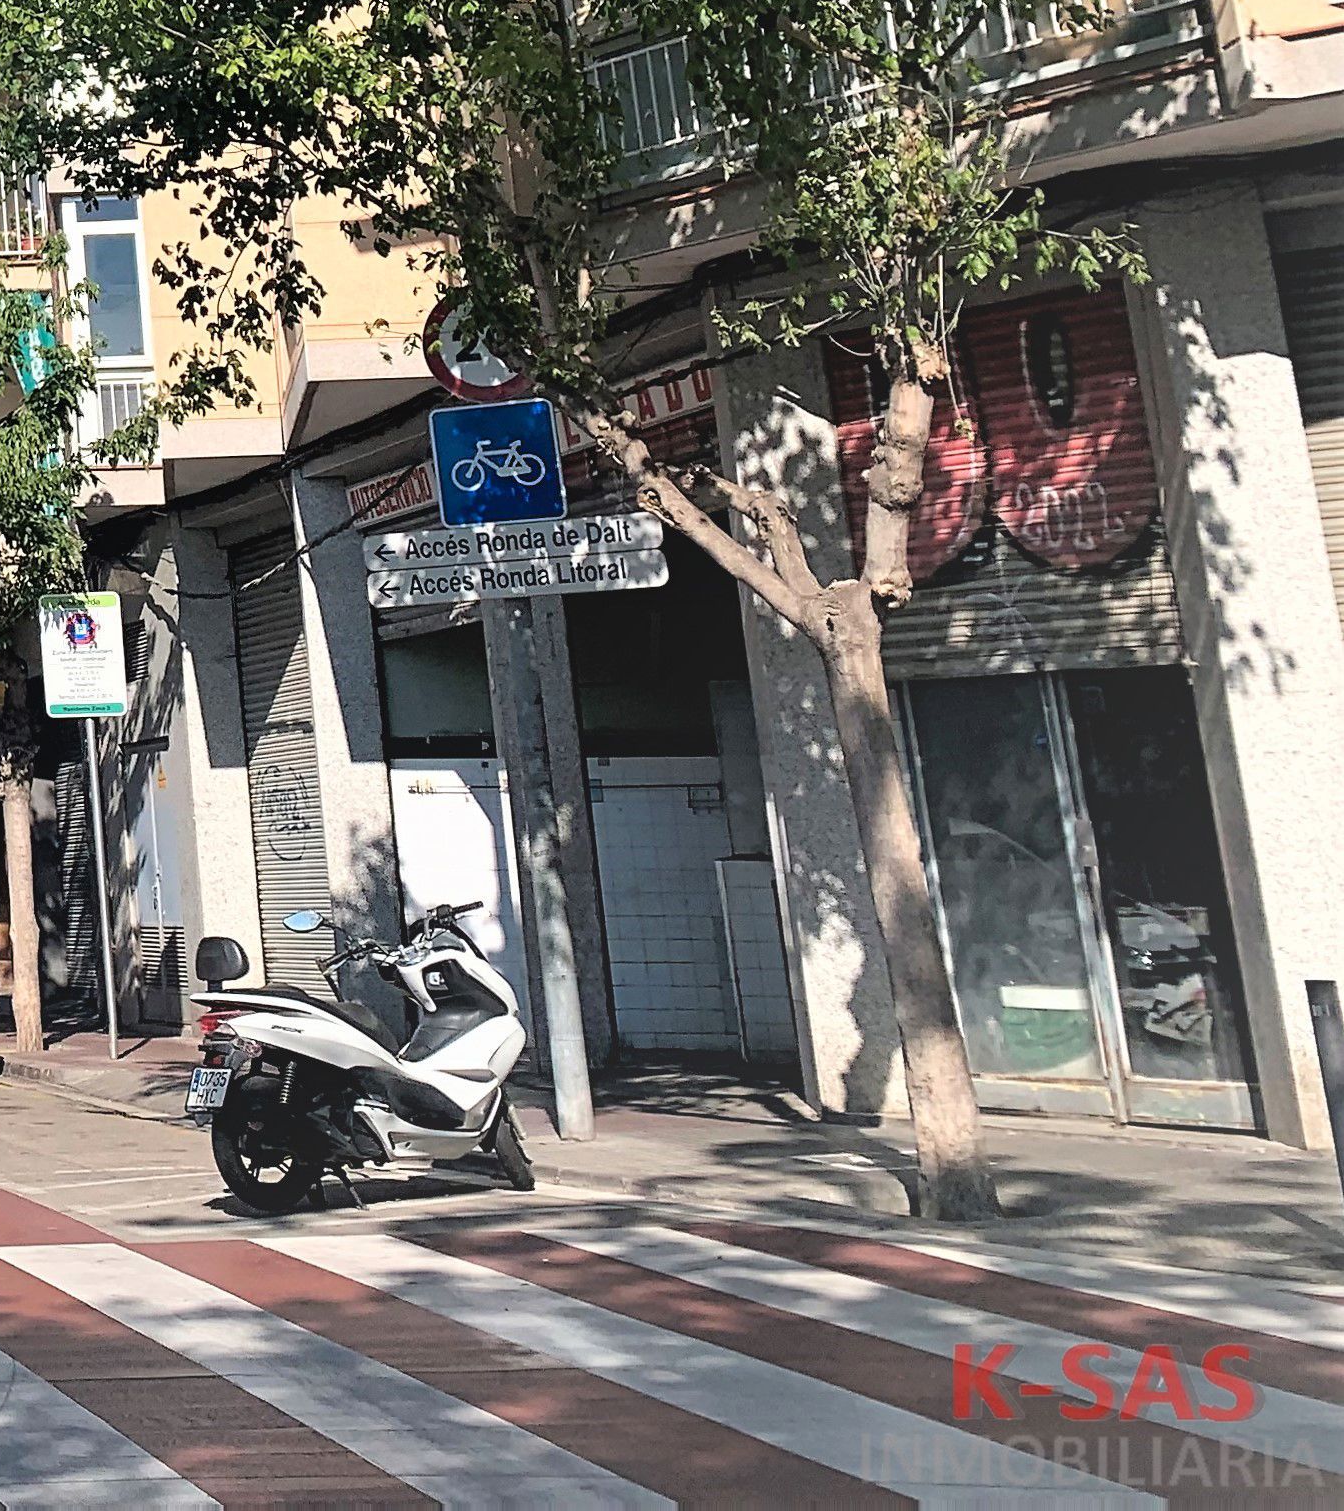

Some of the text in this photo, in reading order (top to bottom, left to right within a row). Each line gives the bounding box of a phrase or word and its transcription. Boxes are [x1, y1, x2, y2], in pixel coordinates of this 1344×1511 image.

[405, 520, 632, 559] Accés Ronda de Dalt
[409, 557, 627, 595] Accés Ronda Litoral
[199, 1071, 228, 1087] 0735
[195, 1088, 218, 1104] HXC
